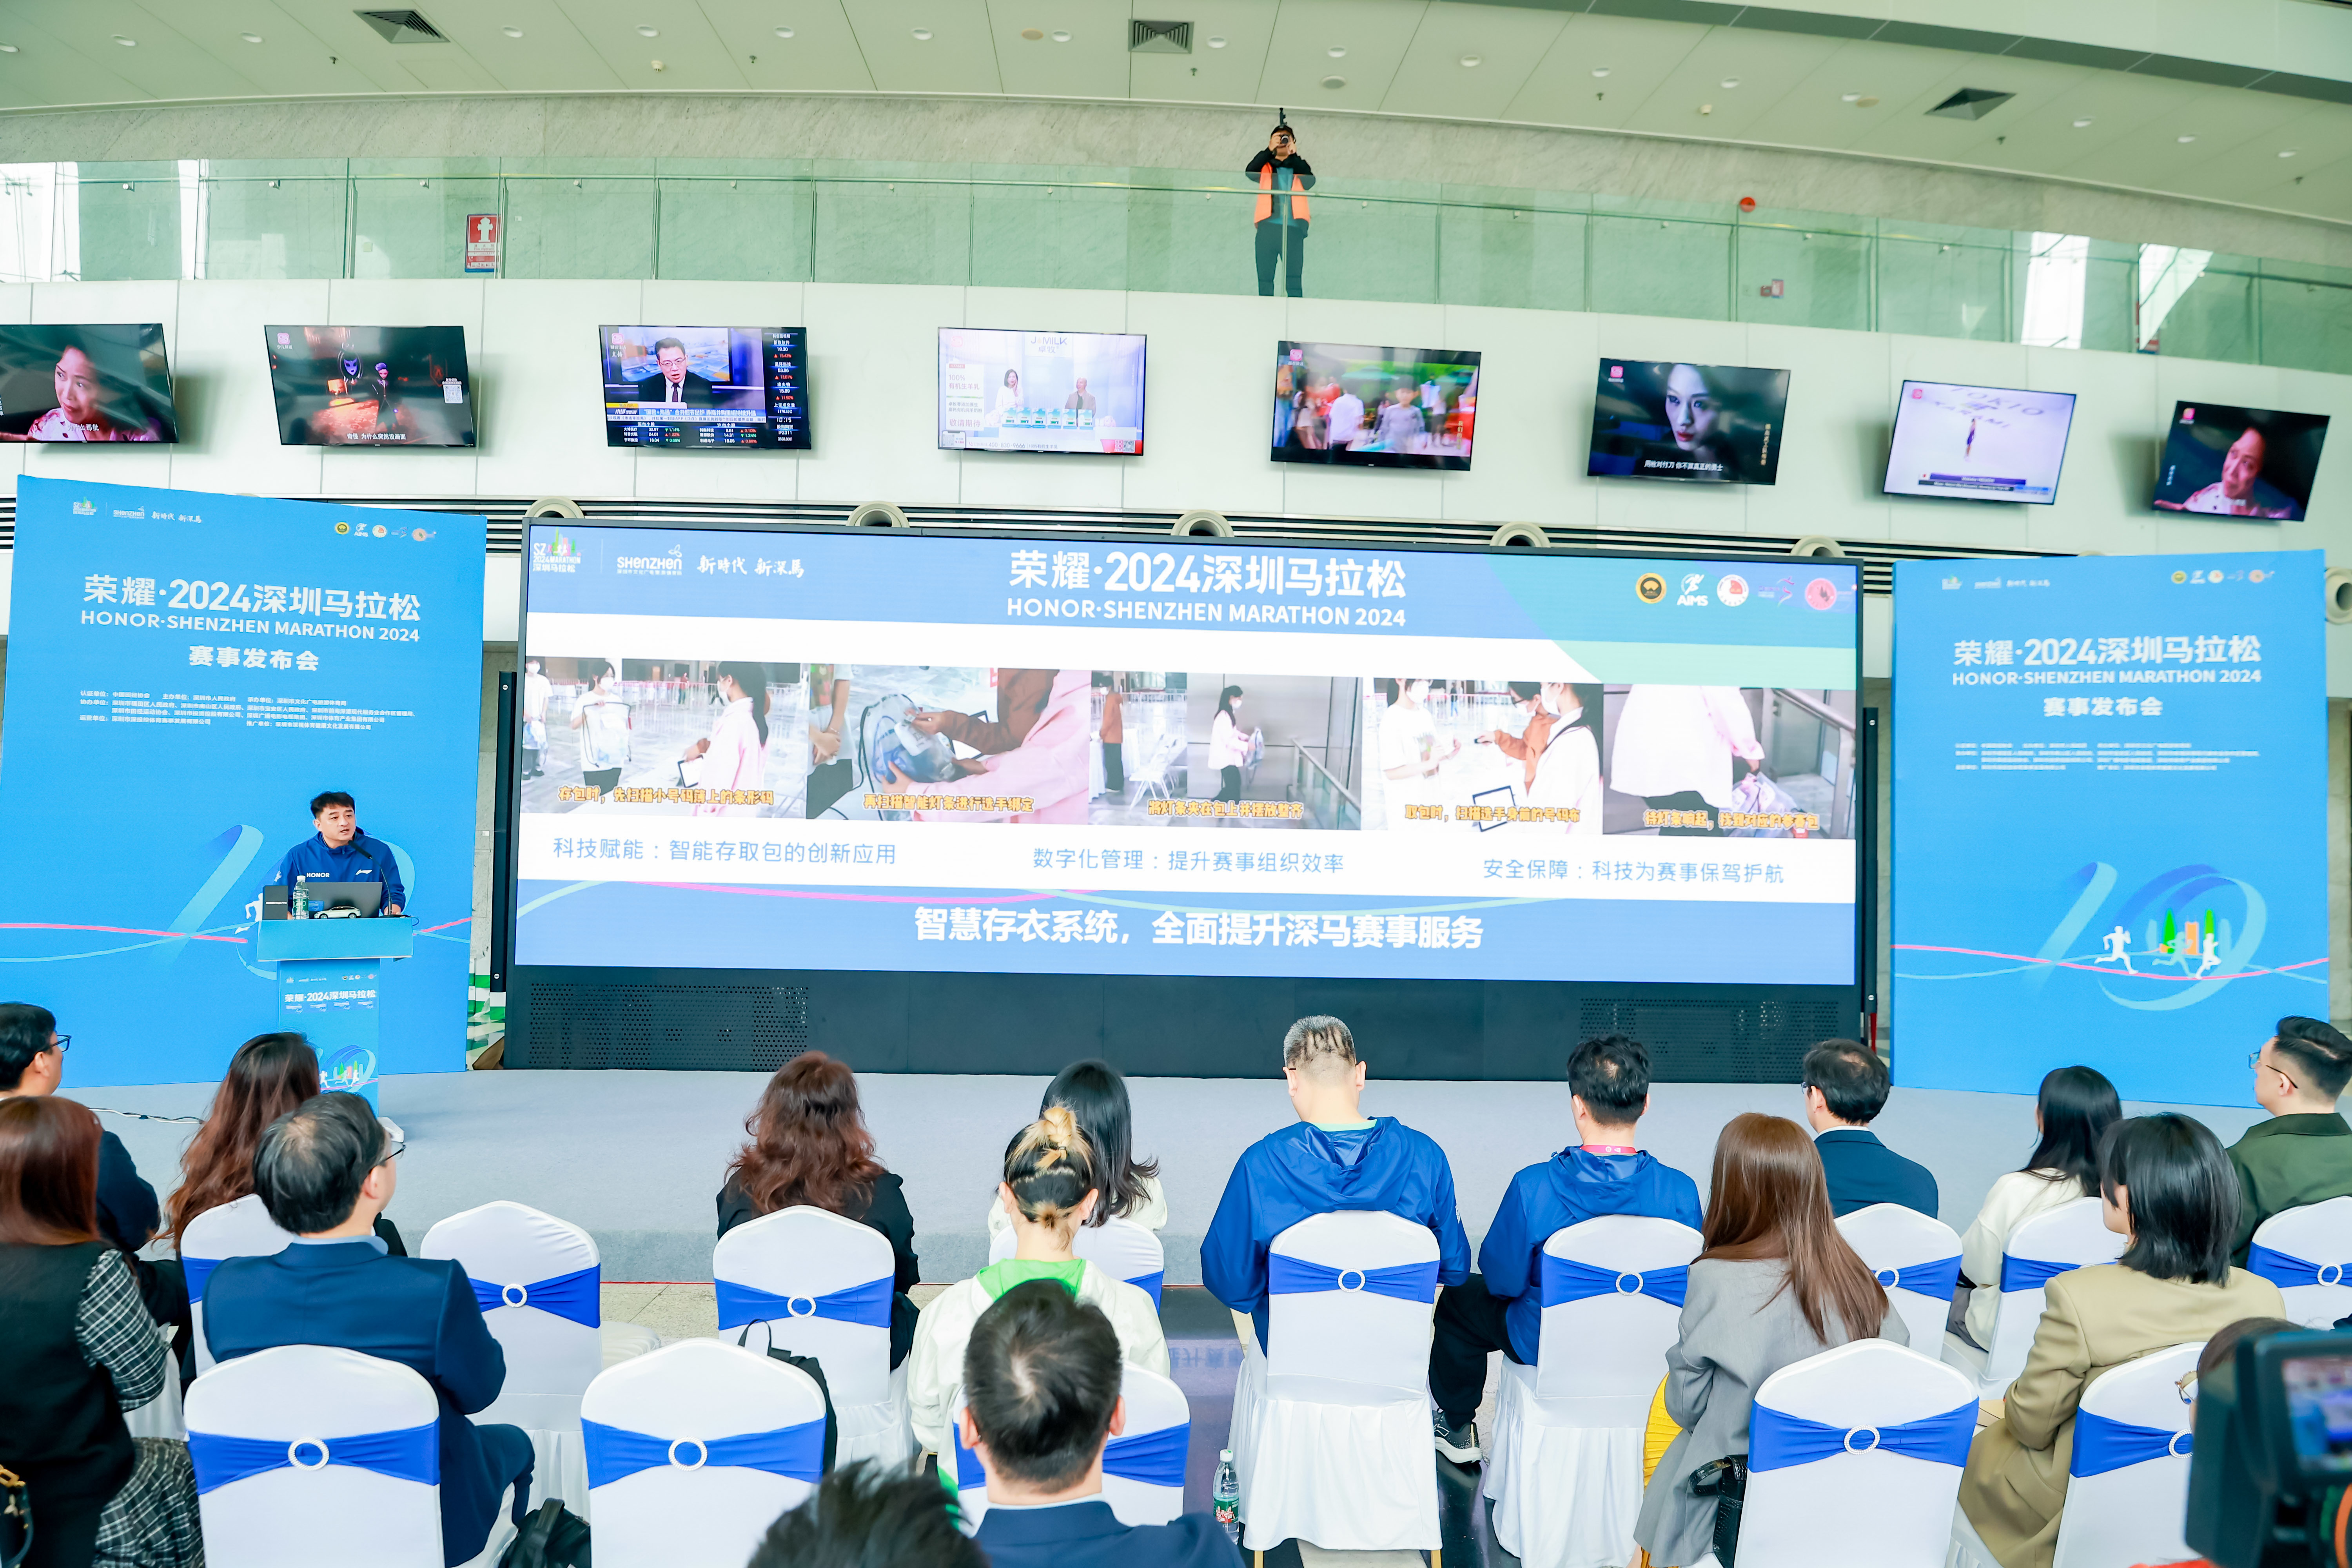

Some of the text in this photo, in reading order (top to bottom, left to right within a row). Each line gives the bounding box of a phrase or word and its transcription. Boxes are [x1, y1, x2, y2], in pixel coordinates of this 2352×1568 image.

[949, 419, 980, 428] 敬请期待
[533, 543, 546, 556] SZ
[532, 563, 575, 573] 深圳马拉松
[1009, 549, 1406, 599] 荣耀·2024深圳马拉松
[83, 574, 420, 622] 荣耀·2024深圳马拉松
[1677, 595, 1709, 606] AIMS
[1229, 604, 1349, 625] MARATHON
[1355, 608, 1406, 627] 2024
[275, 621, 374, 639] MARATHON
[379, 627, 420, 642] 2024
[189, 645, 319, 671] 赛事发布会
[1953, 635, 2262, 666] 荣耀·2024深圳马拉松
[2118, 669, 2216, 683] MARATHON
[2219, 669, 2262, 683] 2024
[2043, 696, 2163, 717] 赛事发布会
[863, 793, 1034, 813] 再扫描智能灯条进行选手绑定
